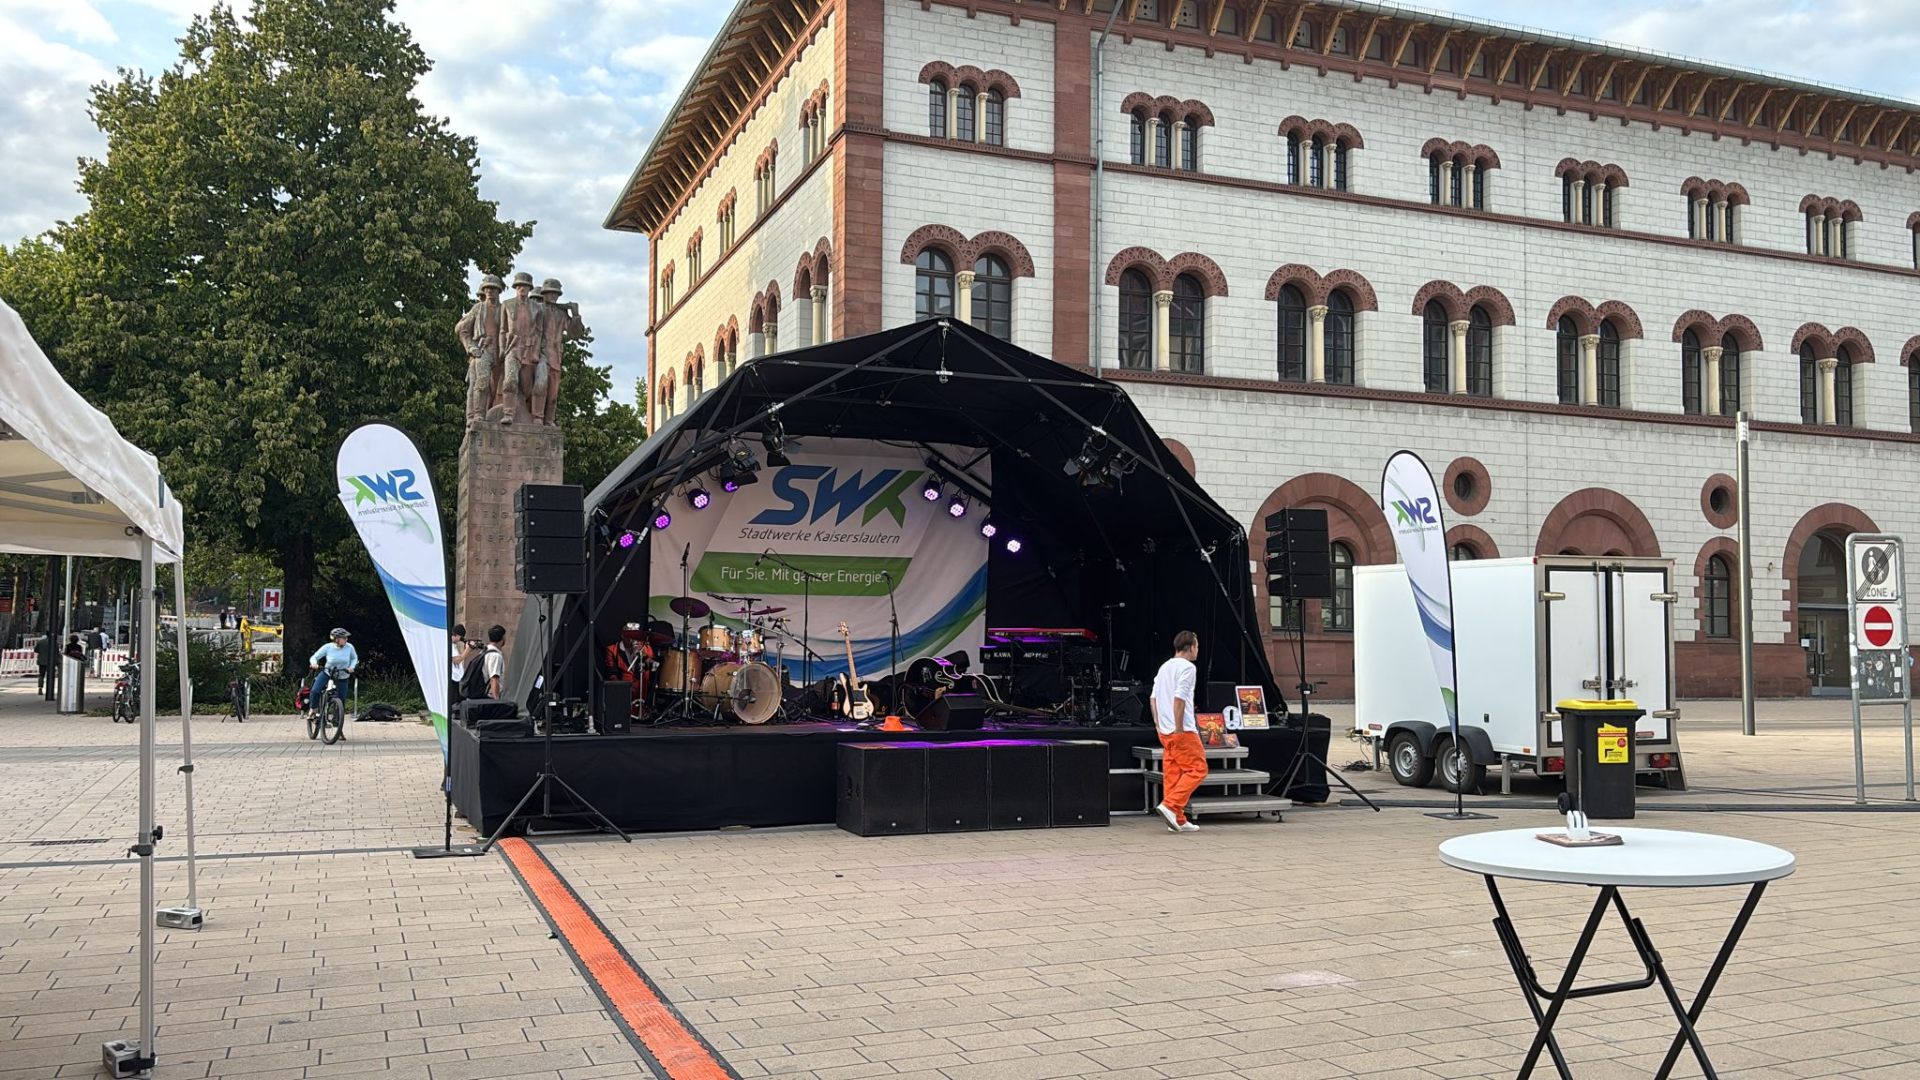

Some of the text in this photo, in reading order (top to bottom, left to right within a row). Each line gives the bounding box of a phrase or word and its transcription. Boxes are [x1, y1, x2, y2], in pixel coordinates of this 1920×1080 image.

[747, 464, 926, 529] SWK
[738, 527, 901, 544] Stadtwerke Kaiserslautern
[721, 566, 885, 586] Für Sie. Mit ganzer Energie.
[265, 591, 280, 607] H
[1866, 587, 1888, 597] ZONE
